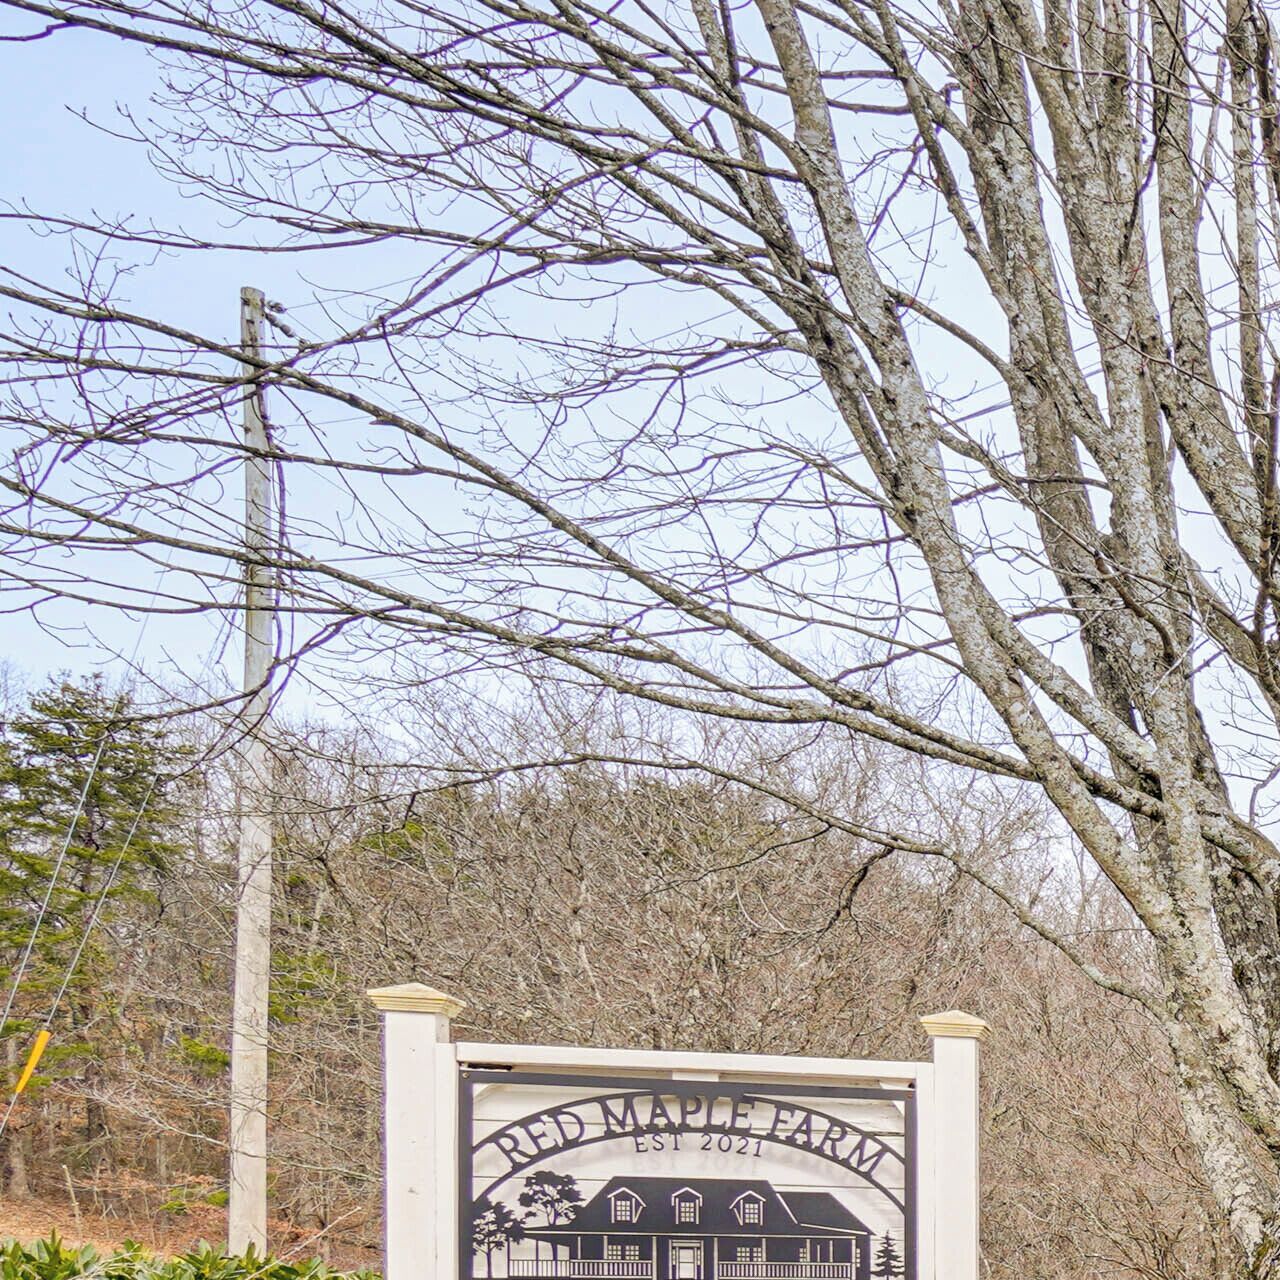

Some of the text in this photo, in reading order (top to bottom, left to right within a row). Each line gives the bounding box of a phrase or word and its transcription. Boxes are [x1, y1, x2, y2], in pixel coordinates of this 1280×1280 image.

[497, 1095, 889, 1178] RED MAPLE FARM
[634, 1133, 763, 1157] EST 2021
